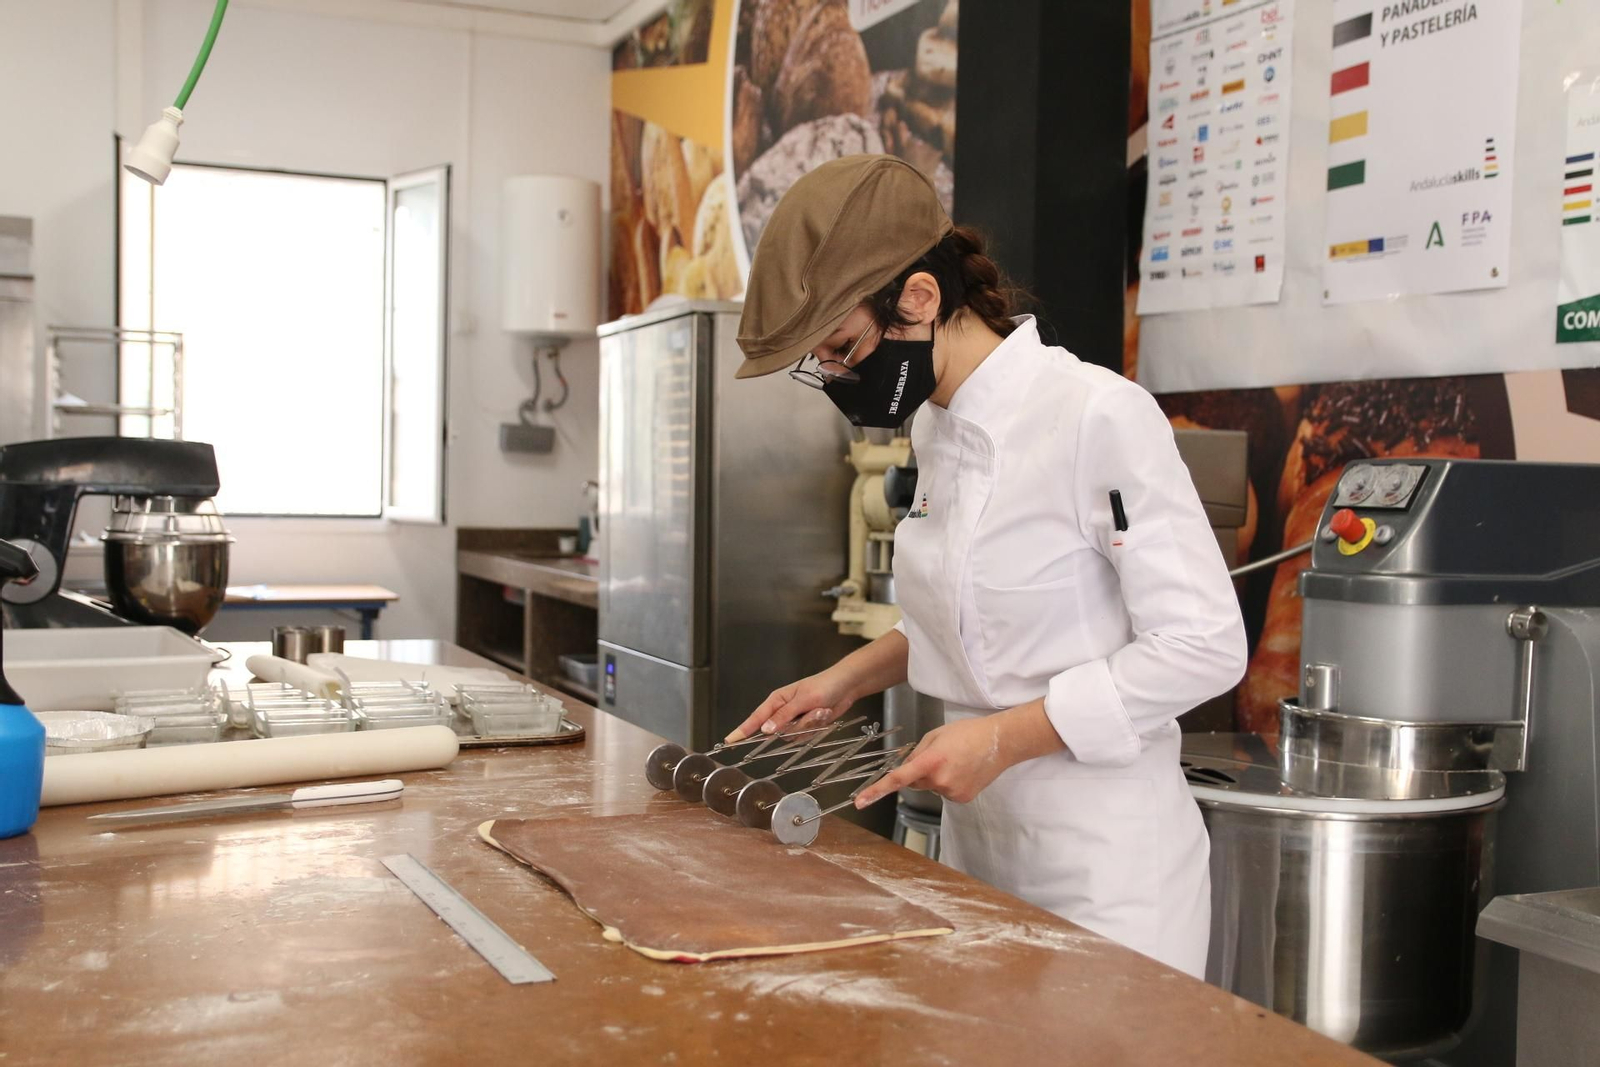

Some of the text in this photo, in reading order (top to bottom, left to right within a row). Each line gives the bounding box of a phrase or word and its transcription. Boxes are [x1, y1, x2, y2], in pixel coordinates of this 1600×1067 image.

[1382, 0, 1453, 22] PANADE
[1381, 3, 1478, 48] Y PASTELERÍA
[1563, 311, 1600, 331] COM
